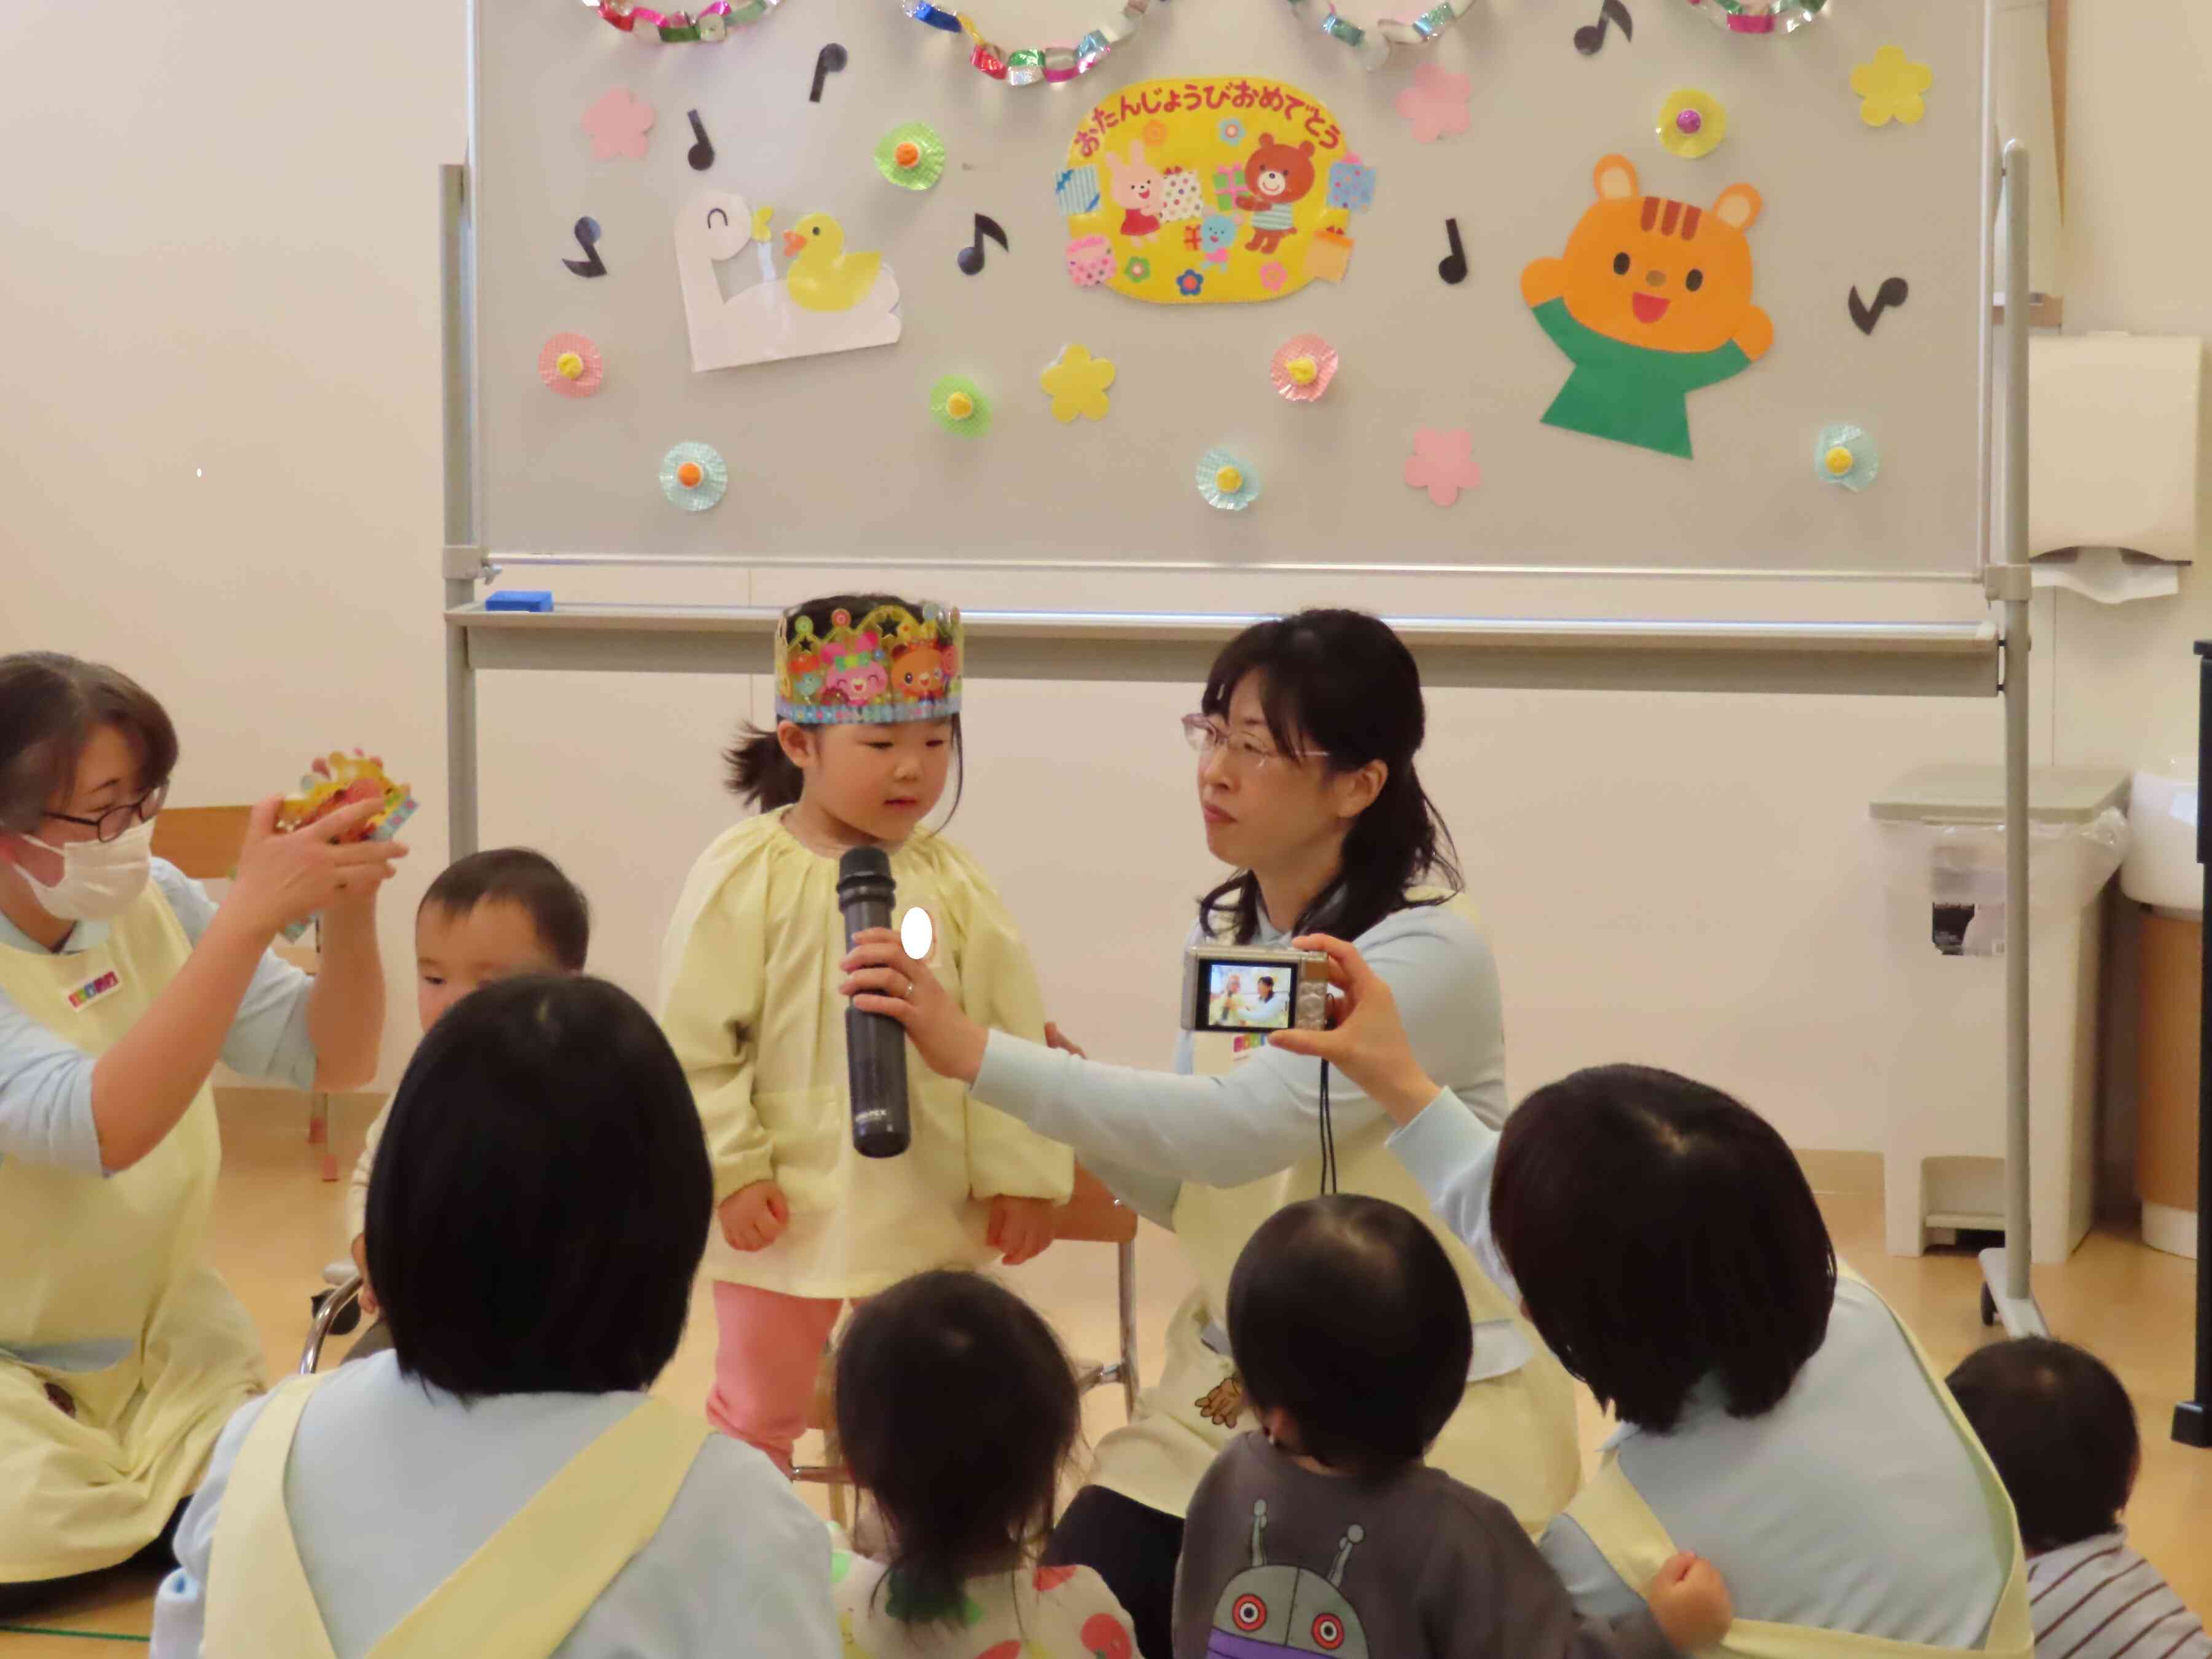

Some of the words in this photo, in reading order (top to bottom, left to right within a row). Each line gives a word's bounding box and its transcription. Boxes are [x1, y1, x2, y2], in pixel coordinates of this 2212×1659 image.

[1074, 80, 1341, 157] おたんじょうびおめでとう
